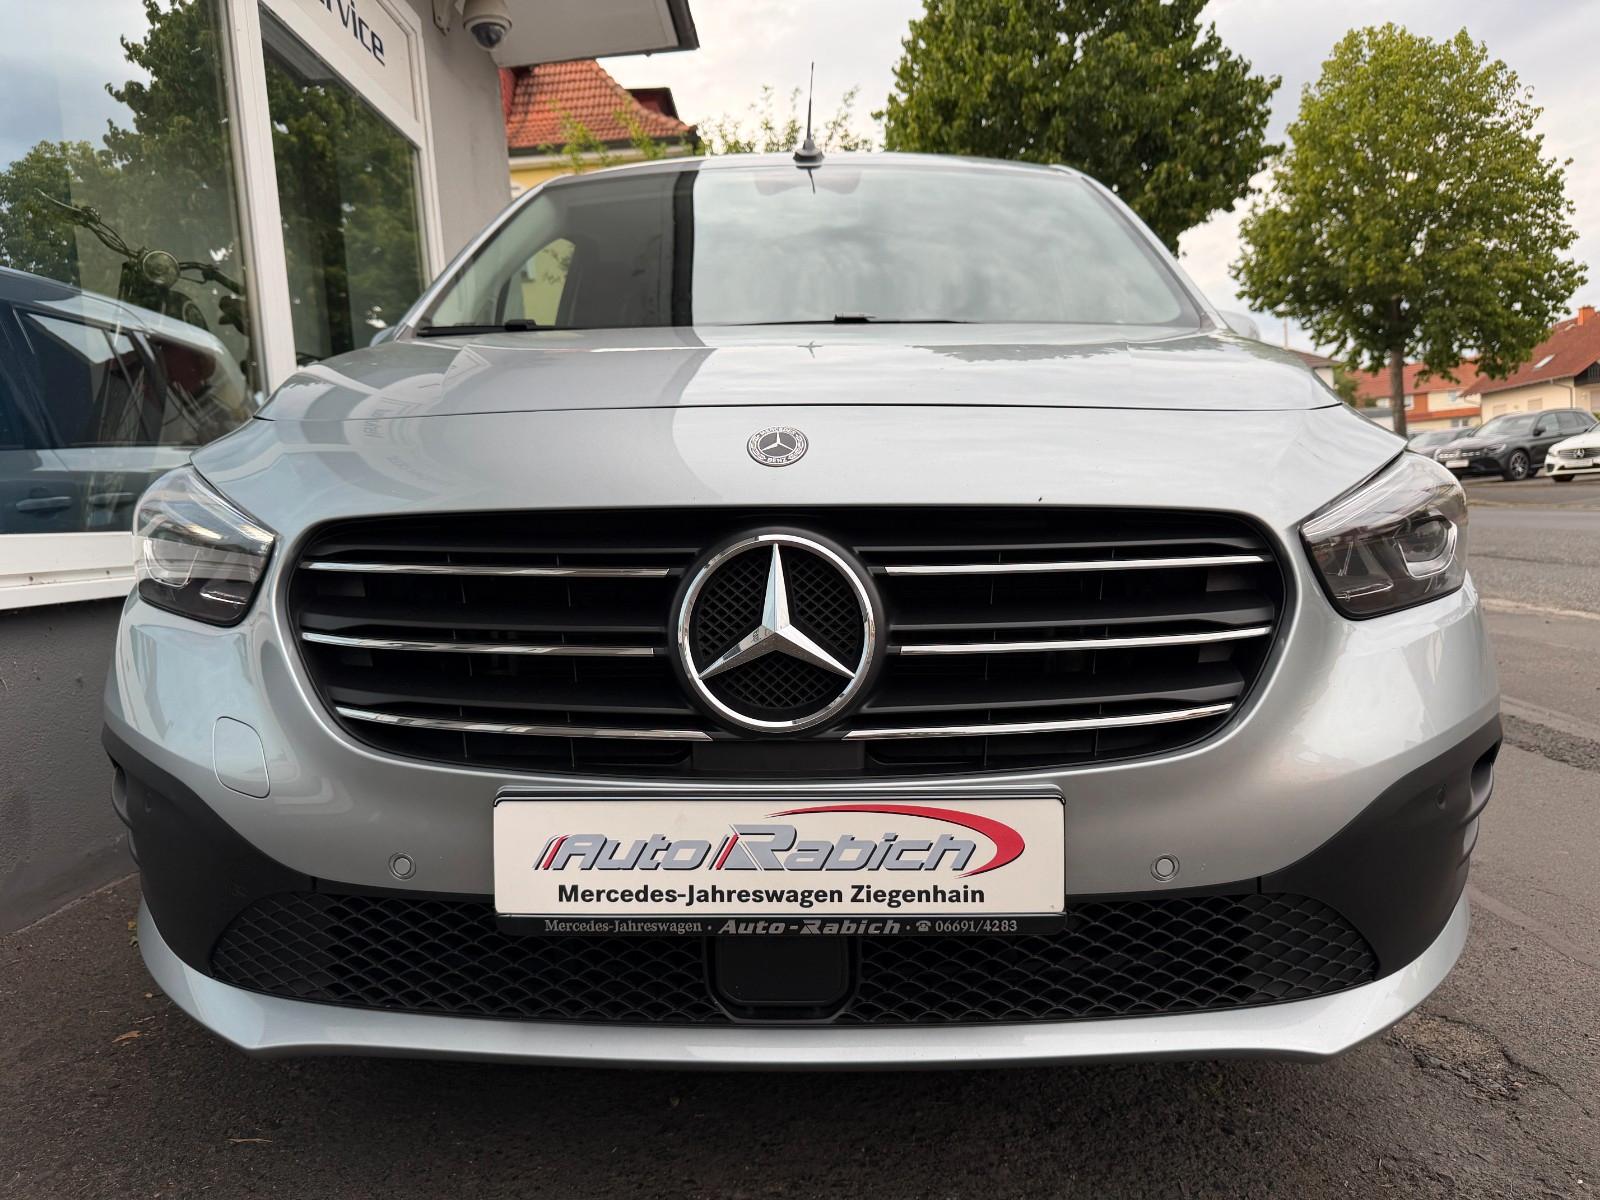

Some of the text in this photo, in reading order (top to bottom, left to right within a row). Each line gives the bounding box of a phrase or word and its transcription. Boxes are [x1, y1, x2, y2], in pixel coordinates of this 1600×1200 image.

[558, 884, 985, 909] Mercedes-Jahreswagen Ziegenhain
[544, 919, 1018, 935] Mercedes-Jahreswagen Auto-Rabich 06691/4283
